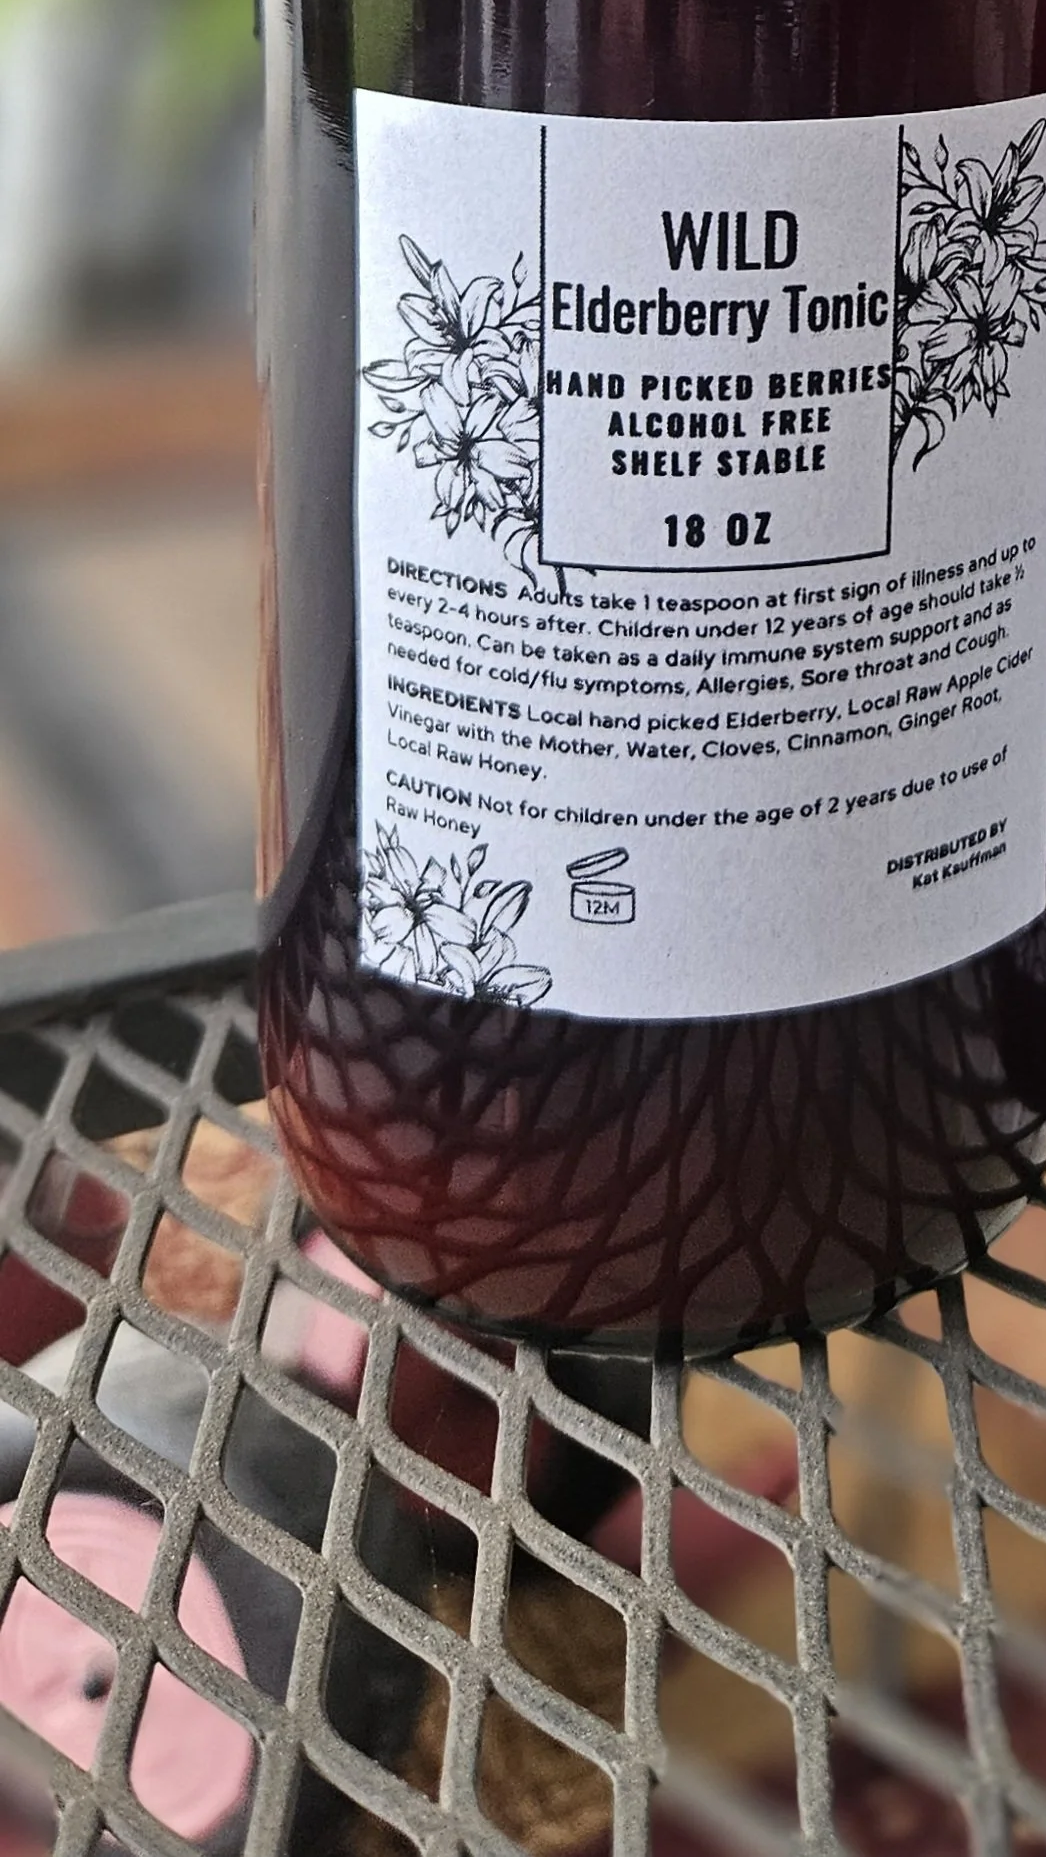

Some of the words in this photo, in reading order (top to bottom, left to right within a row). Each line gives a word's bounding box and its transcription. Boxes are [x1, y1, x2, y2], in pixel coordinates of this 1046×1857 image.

[662, 209, 798, 272] WILD
[553, 282, 769, 342] Elderberry
[784, 283, 888, 333] Tonic
[546, 370, 625, 400] HAND
[642, 371, 753, 400] PICKED
[769, 364, 891, 398] BERRIES
[607, 411, 747, 439] ALCOHOL
[763, 405, 832, 435] FREE
[611, 449, 702, 477] SHELF
[718, 445, 827, 475] STABLE
[664, 515, 705, 547] 18
[727, 512, 771, 545] OZ
[388, 556, 508, 598] DIRECTIONS
[591, 593, 637, 611] take
[657, 594, 759, 615] teaspoon
[766, 593, 787, 608] at
[794, 587, 835, 605] first
[841, 581, 880, 602] sign
[887, 573, 907, 592] of
[912, 562, 964, 588] illness
[968, 548, 997, 573] and
[1001, 544, 1019, 563] up
[1023, 536, 1036, 553] to
[388, 586, 433, 614] every
[438, 597, 470, 618] 2-4
[476, 604, 529, 628] hours
[536, 614, 592, 635] after.
[598, 619, 689, 639] Children
[695, 620, 758, 638] under
[766, 617, 785, 634] 12
[791, 611, 847, 637] years
[853, 604, 873, 624] of
[879, 601, 913, 622] age
[918, 582, 975, 613] should
[980, 571, 1011, 593] take
[388, 612, 471, 647] teaspoon.
[477, 633, 515, 655] Can
[521, 640, 546, 659] be
[553, 645, 612, 665] taken
[617, 652, 640, 667] as
[665, 649, 716, 671] daily
[721, 643, 806, 666] immune
[812, 633, 884, 661] system
[889, 615, 959, 646] support
[963, 601, 992, 627] and
[995, 597, 1013, 615] as
[388, 641, 450, 670] needed
[456, 656, 483, 677] for
[488, 667, 568, 690] cold/flu
[573, 675, 690, 697] symptoms,
[696, 675, 795, 696] Allergies,
[801, 667, 848, 687] Sore
[855, 655, 914, 680] throat
[918, 642, 951, 666] and
[955, 623, 1010, 655] Cough.
[388, 674, 521, 720] INGREDIENTS
[528, 704, 583, 727] Local
[589, 712, 641, 730] hand
[648, 713, 719, 734] picked
[726, 703, 842, 729] Elderberry,
[848, 690, 901, 716] Local
[906, 682, 942, 704] Raw
[947, 664, 993, 696] Apple
[997, 646, 1033, 675] Cider
[388, 701, 451, 734] Vinegar
[457, 723, 494, 742] with
[502, 730, 532, 749] the
[540, 734, 619, 759] Mother,
[627, 742, 696, 761] Water,
[702, 740, 780, 758] Cloves,
[788, 722, 892, 752] Cinnamon,
[898, 703, 957, 732] Ginger
[962, 688, 1002, 713] Root,
[388, 729, 431, 756] Local
[437, 743, 472, 766] Raw
[479, 753, 547, 781] Honey.
[386, 769, 472, 807] CAUTION
[478, 796, 513, 816] Not
[520, 800, 548, 819] for
[554, 806, 638, 826] children
[645, 811, 707, 828] under
[714, 808, 748, 825] the
[755, 806, 794, 826] age
[800, 797, 822, 818] of
[827, 797, 839, 814] 2
[845, 788, 897, 816] years
[902, 777, 935, 797] due
[940, 770, 957, 786] to
[962, 758, 988, 779] use
[992, 744, 1007, 766] of
[387, 795, 419, 820] Raw
[424, 807, 481, 839] Honey
[887, 828, 986, 874] DISTRIBUTED
[990, 817, 1007, 838] BY
[585, 898, 619, 915] 12M
[913, 869, 939, 889] Kat
